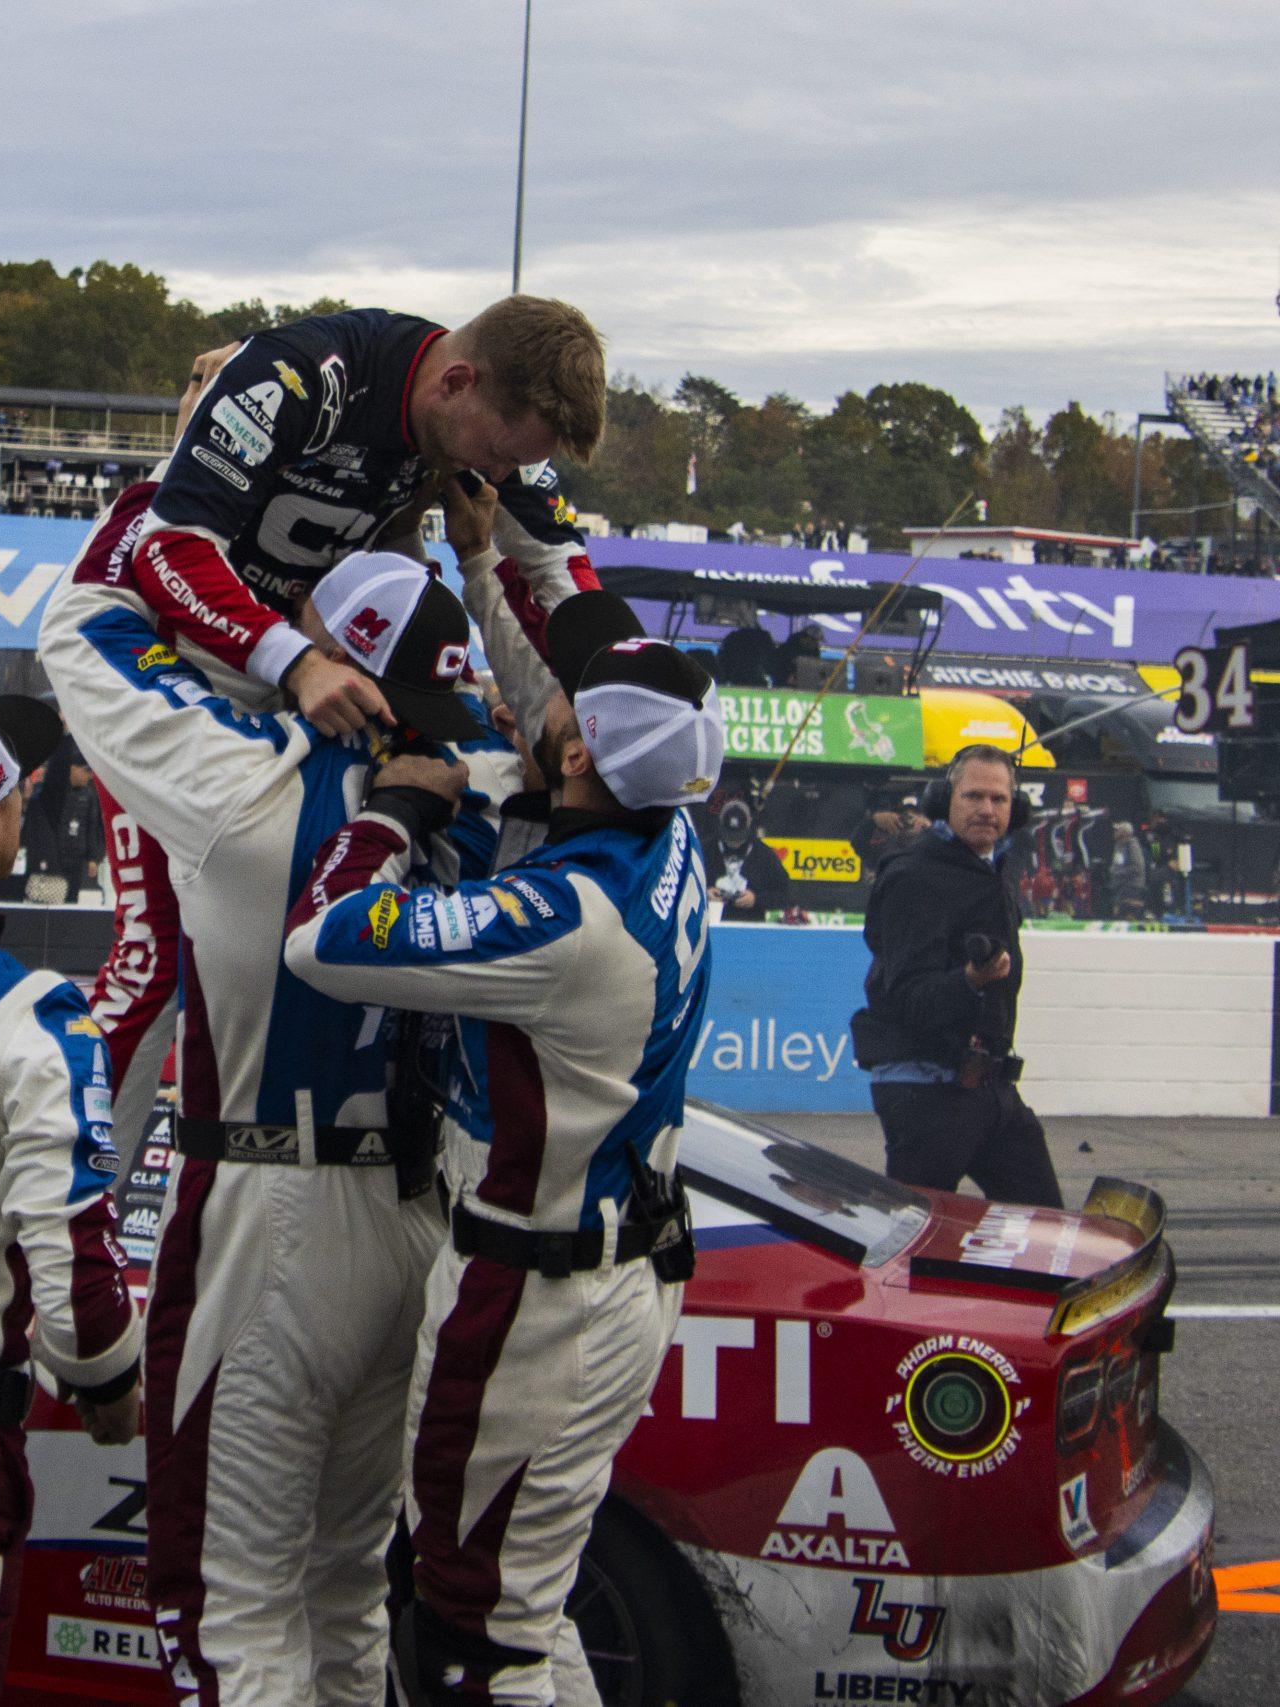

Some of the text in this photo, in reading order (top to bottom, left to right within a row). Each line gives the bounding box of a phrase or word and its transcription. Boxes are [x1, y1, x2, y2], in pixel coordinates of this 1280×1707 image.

[220, 406, 265, 453] SIEMENS
[235, 393, 275, 434] AXALTA
[196, 450, 245, 488] FREIGHTLINER
[146, 540, 253, 646] CINCINNATI
[1175, 645, 1254, 733] 34
[721, 696, 823, 727] RILLO'S
[722, 727, 824, 756] ICKLES
[372, 891, 395, 948] SUNOCO
[513, 880, 555, 919] NASCAR
[896, 1335, 1022, 1384] PHORM ENERGY
[892, 1420, 1022, 1479] PHORM ENERGY
[760, 1532, 911, 1569] AXALTA
[814, 1672, 974, 1704] LIBERTY
